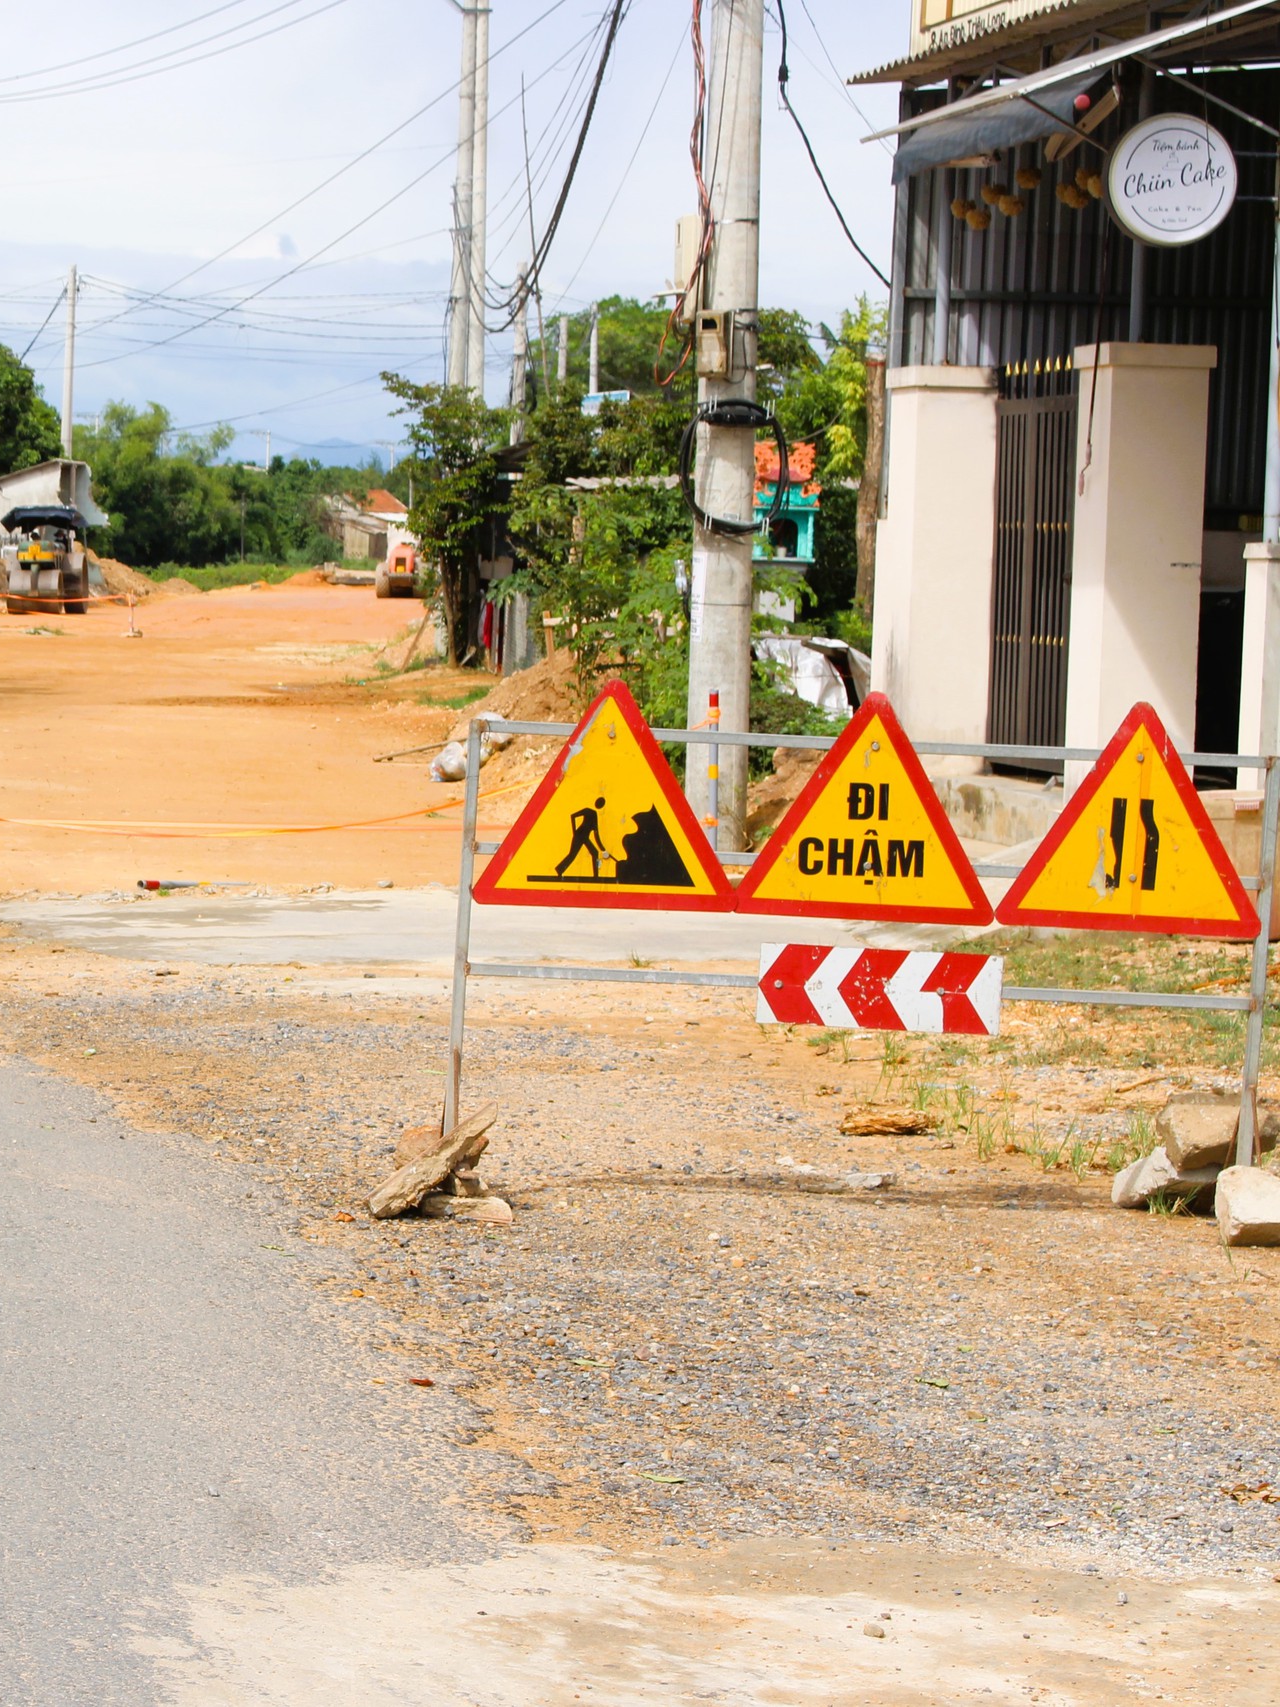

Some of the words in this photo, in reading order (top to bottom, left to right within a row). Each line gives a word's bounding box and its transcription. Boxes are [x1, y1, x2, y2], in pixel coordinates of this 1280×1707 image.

[1124, 172, 1174, 198] Chiin
[1180, 158, 1227, 187] Cake
[847, 782, 889, 821] ĐI
[798, 828, 925, 886] CHẬM
